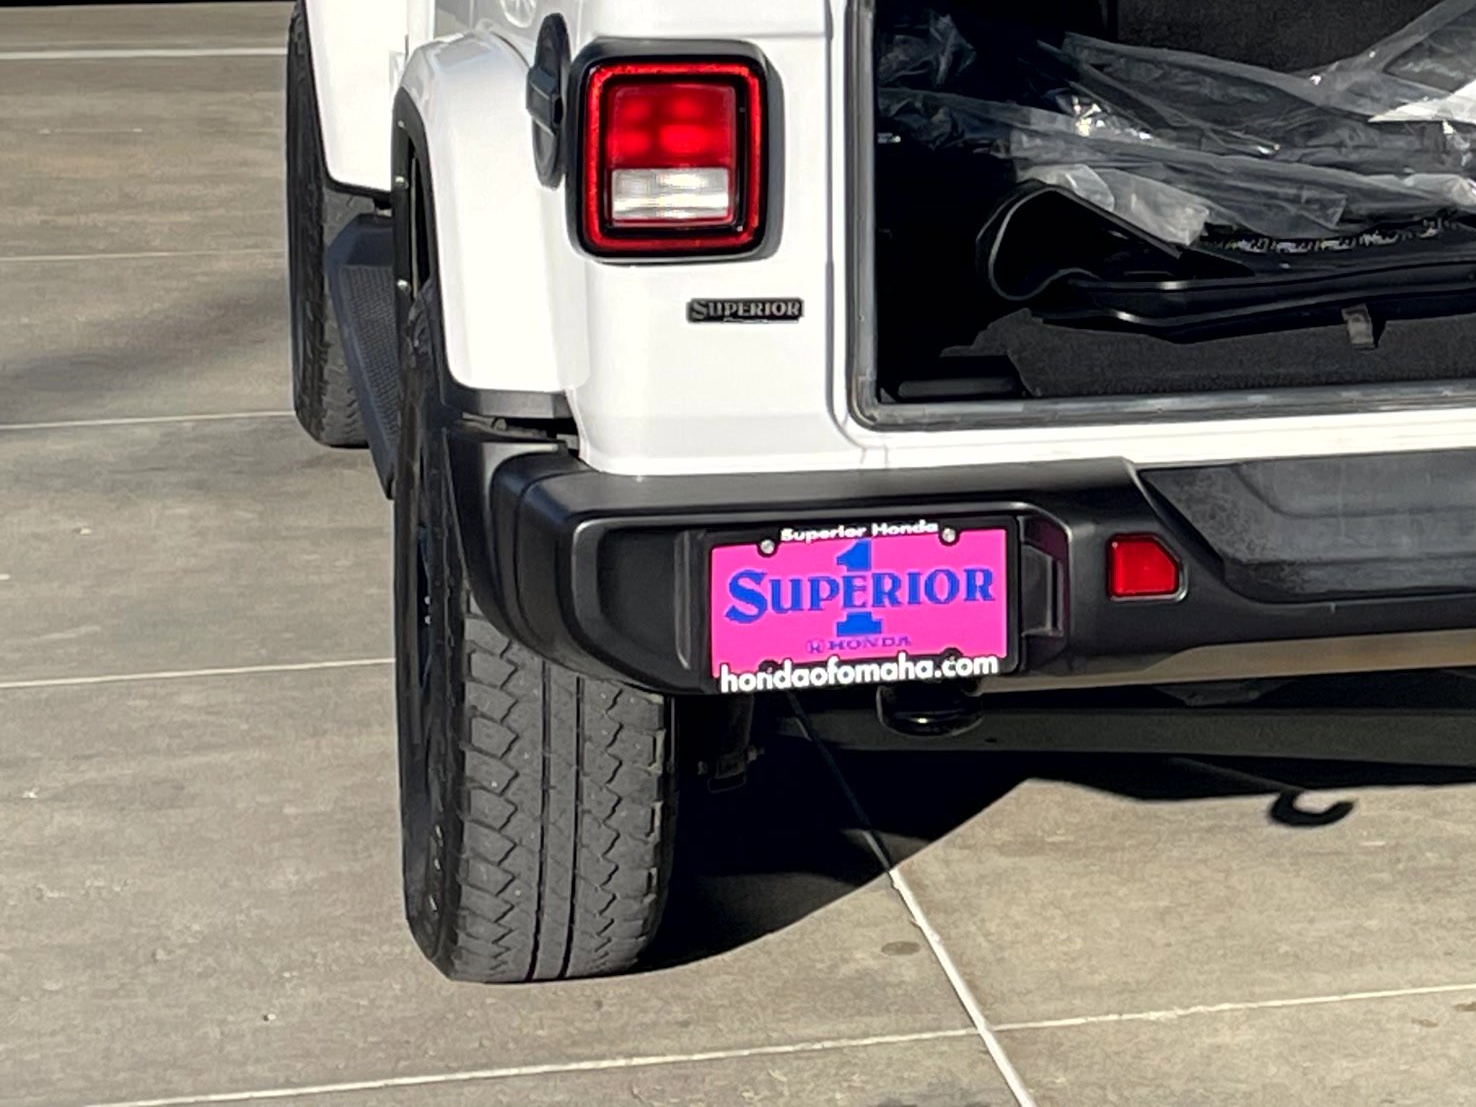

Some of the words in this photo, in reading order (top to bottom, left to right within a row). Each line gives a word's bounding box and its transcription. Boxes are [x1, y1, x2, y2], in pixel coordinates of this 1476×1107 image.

[692, 299, 801, 319] SUPERIOR
[780, 526, 867, 543] Superior
[872, 519, 939, 536] Honda
[725, 567, 994, 623] SUPERIOR
[827, 636, 910, 650] HONDA
[720, 651, 998, 692] hondaofomaha.com
